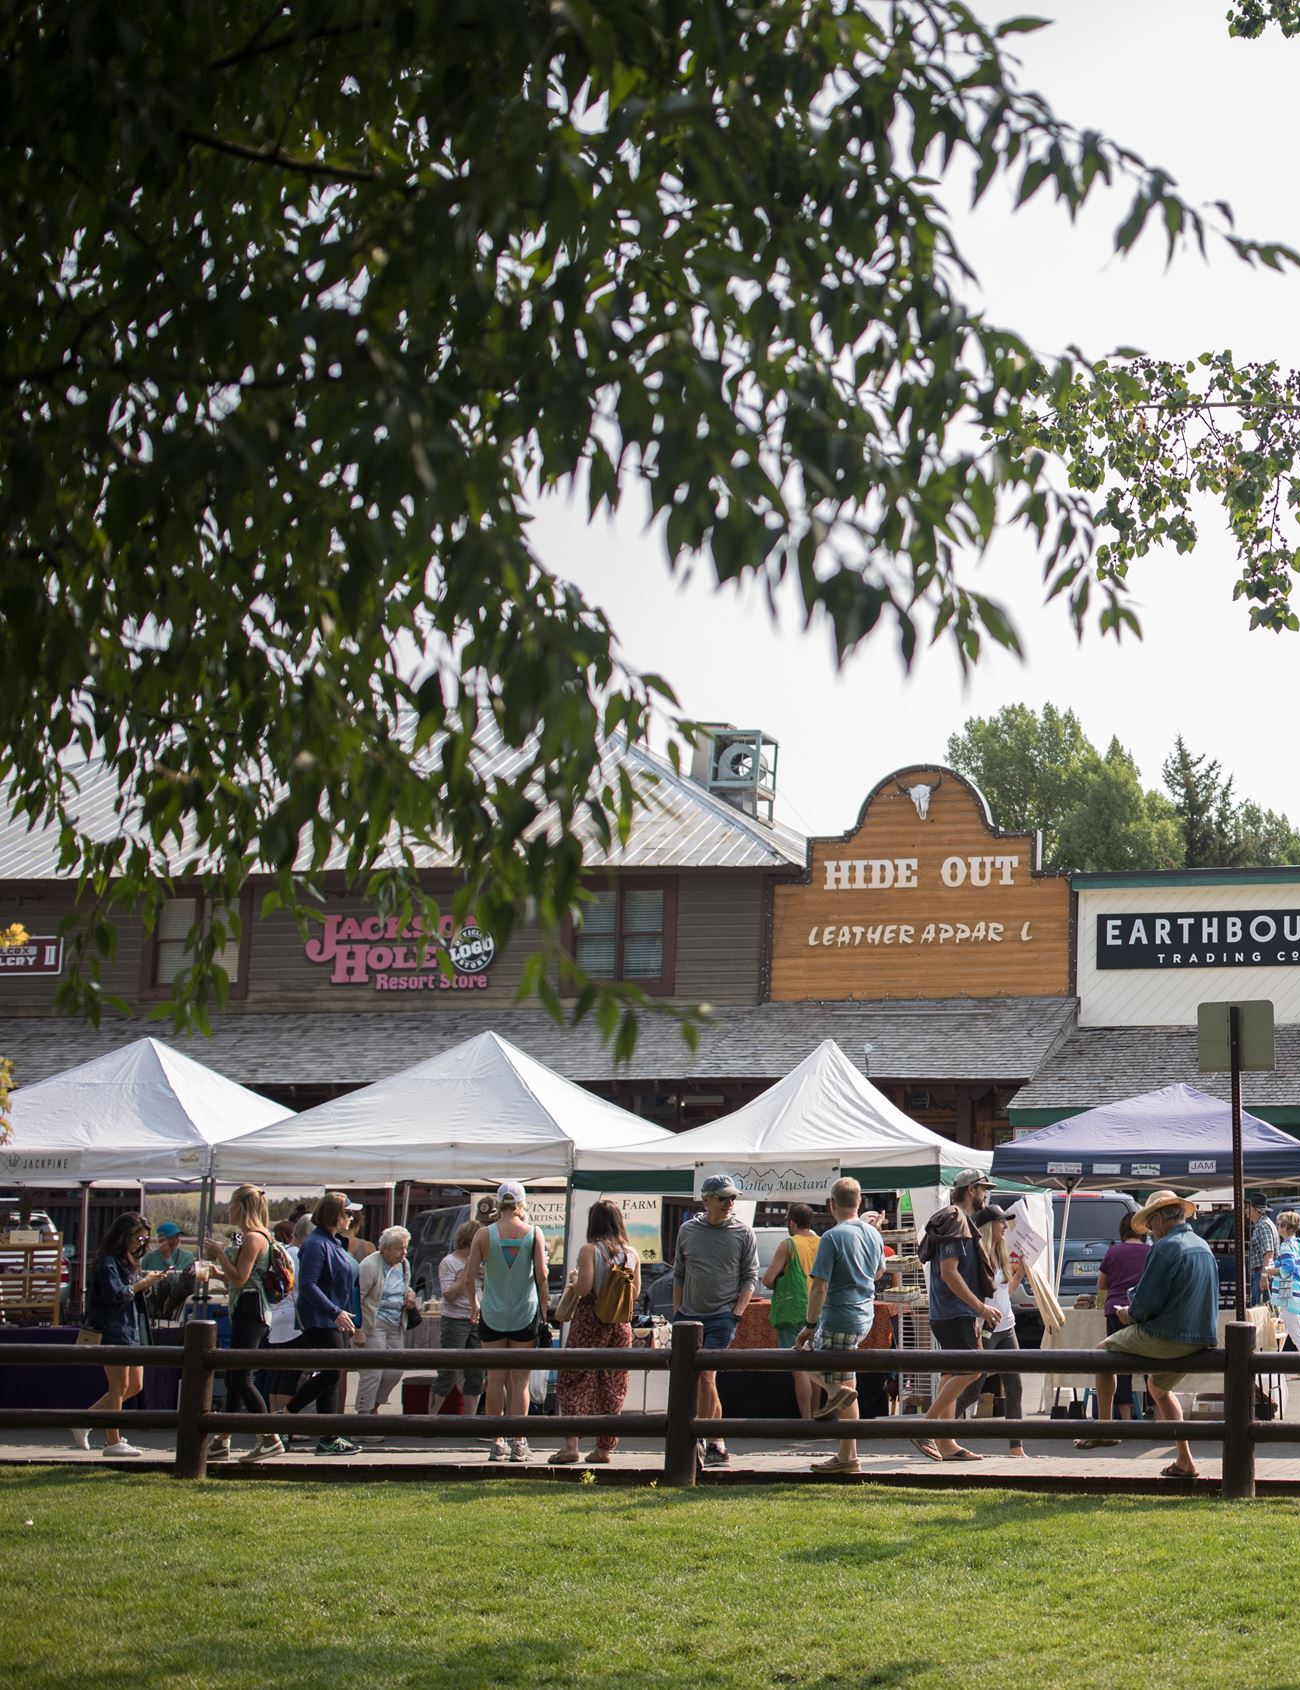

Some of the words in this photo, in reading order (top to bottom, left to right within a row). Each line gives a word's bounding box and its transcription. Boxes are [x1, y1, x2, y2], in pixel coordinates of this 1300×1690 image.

[823, 858, 918, 890] HIDE
[941, 856, 1019, 887] OUT
[808, 924, 915, 948] LEATHER
[449, 937, 494, 961] LOGO
[1158, 951, 1261, 964] TRADING
[331, 944, 438, 984] HOLE
[375, 974, 435, 990] Resort
[439, 973, 487, 989] Store
[23, 1158, 69, 1169] JACKPINE
[1190, 1161, 1215, 1170] JAM
[737, 1179, 774, 1195] Valley
[776, 1176, 831, 1191] Mustard
[622, 1199, 657, 1211] FARM
